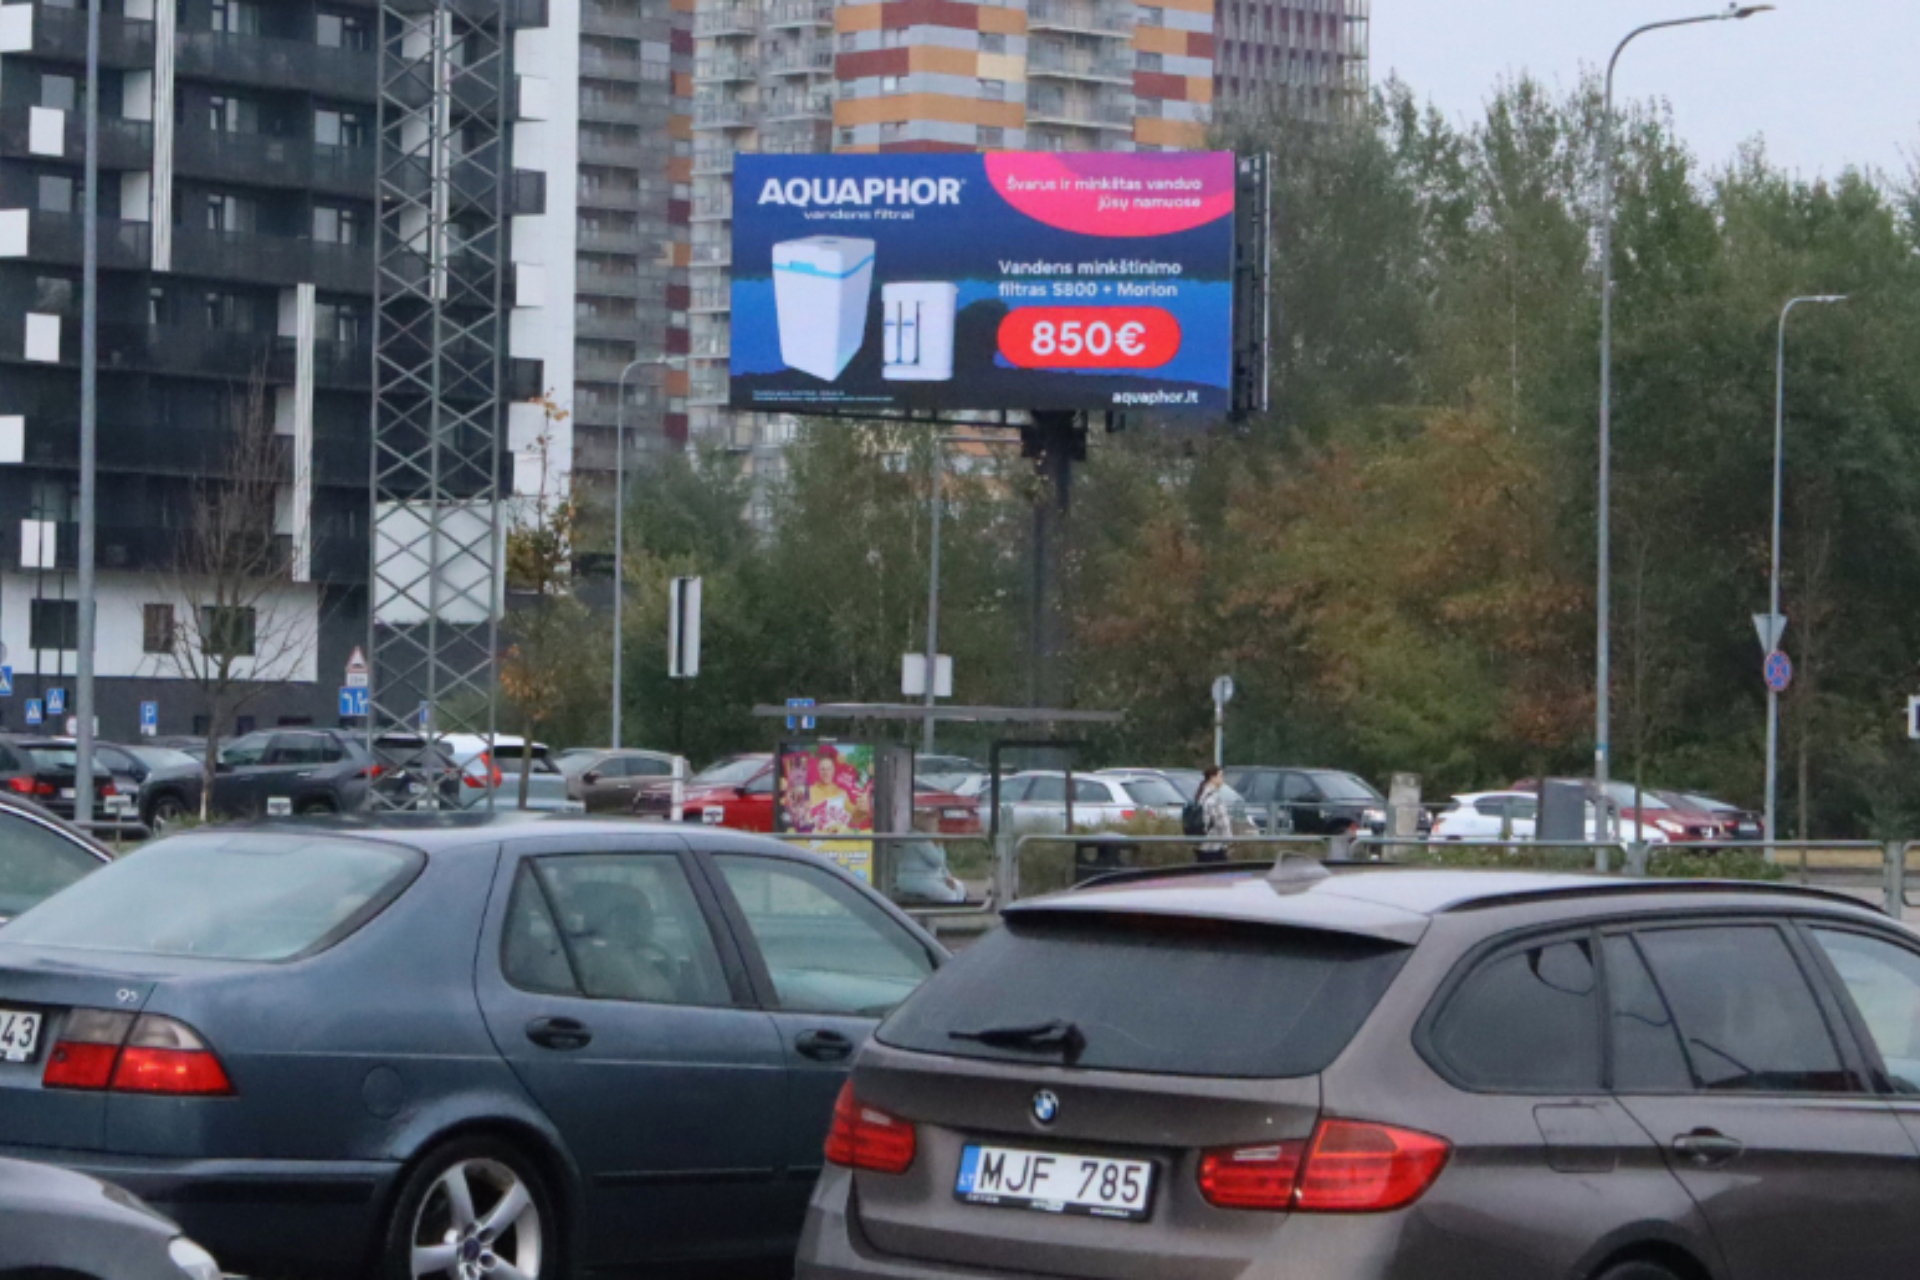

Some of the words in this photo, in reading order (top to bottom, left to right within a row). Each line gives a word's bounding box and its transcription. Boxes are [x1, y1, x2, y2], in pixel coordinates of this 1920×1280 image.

[1006, 174, 1056, 190] Švarus
[1060, 177, 1071, 190] ir
[1075, 176, 1142, 191] minkštas
[1146, 176, 1203, 190] vanduo
[757, 177, 961, 207] AQUAPHOR
[1132, 197, 1202, 208] namuose
[804, 209, 872, 220] vandens
[874, 208, 915, 220] filtrai
[998, 260, 1074, 275] Vandens
[1077, 259, 1183, 275] minkštinimo
[998, 282, 1047, 297] filtras
[1052, 282, 1098, 297] S800
[1117, 282, 1178, 297] Morion
[1031, 320, 1146, 356] 850€
[1112, 389, 1199, 406] aquaphor.lt
[0, 1013, 36, 1049] 43
[977, 1151, 1057, 1194] MJF
[1076, 1160, 1142, 1204] 785
